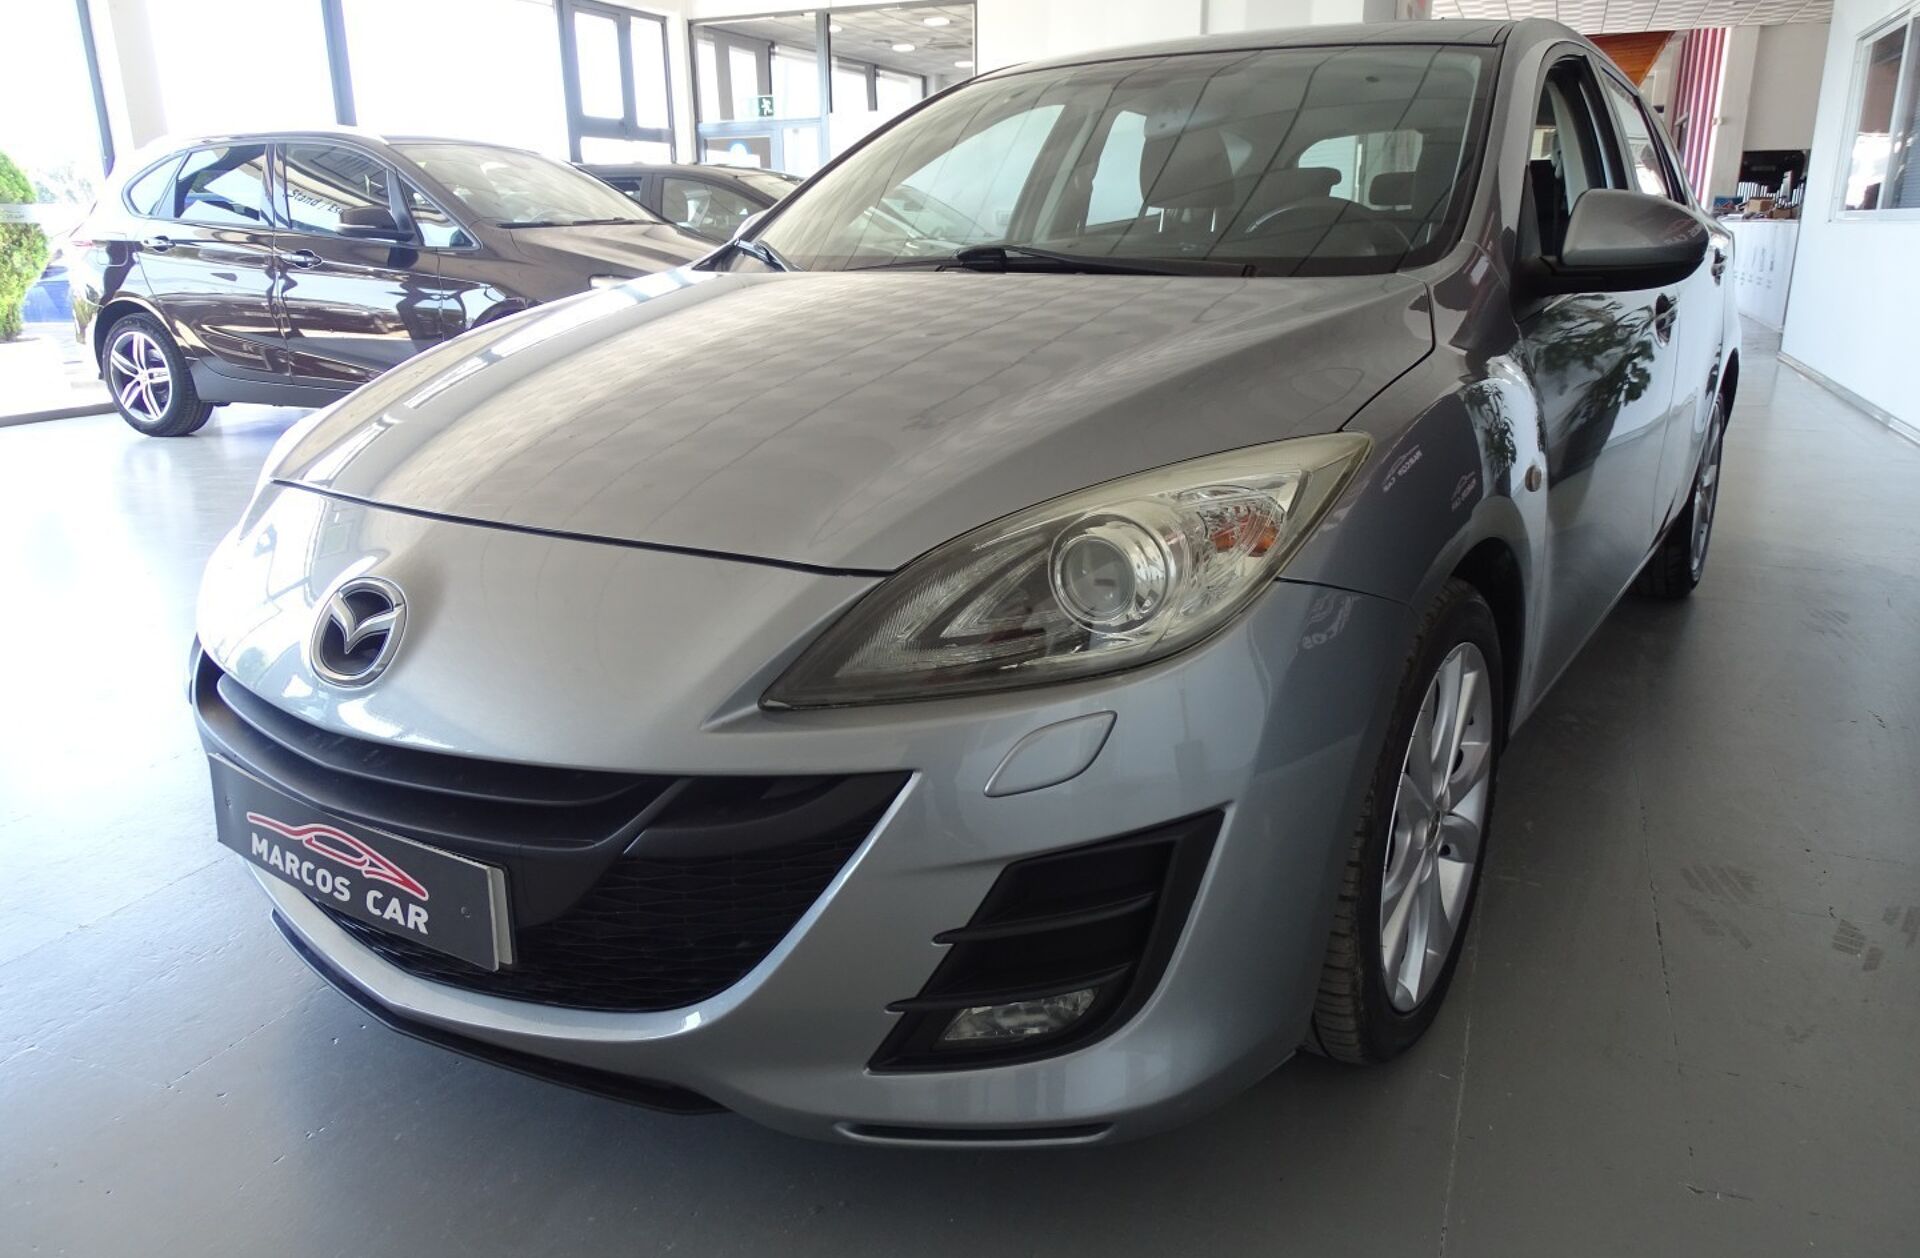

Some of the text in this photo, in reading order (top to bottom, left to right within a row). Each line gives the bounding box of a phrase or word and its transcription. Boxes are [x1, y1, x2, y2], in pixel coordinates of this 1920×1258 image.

[289, 189, 322, 206] Stand
[251, 833, 429, 934] MARCOS CAR
